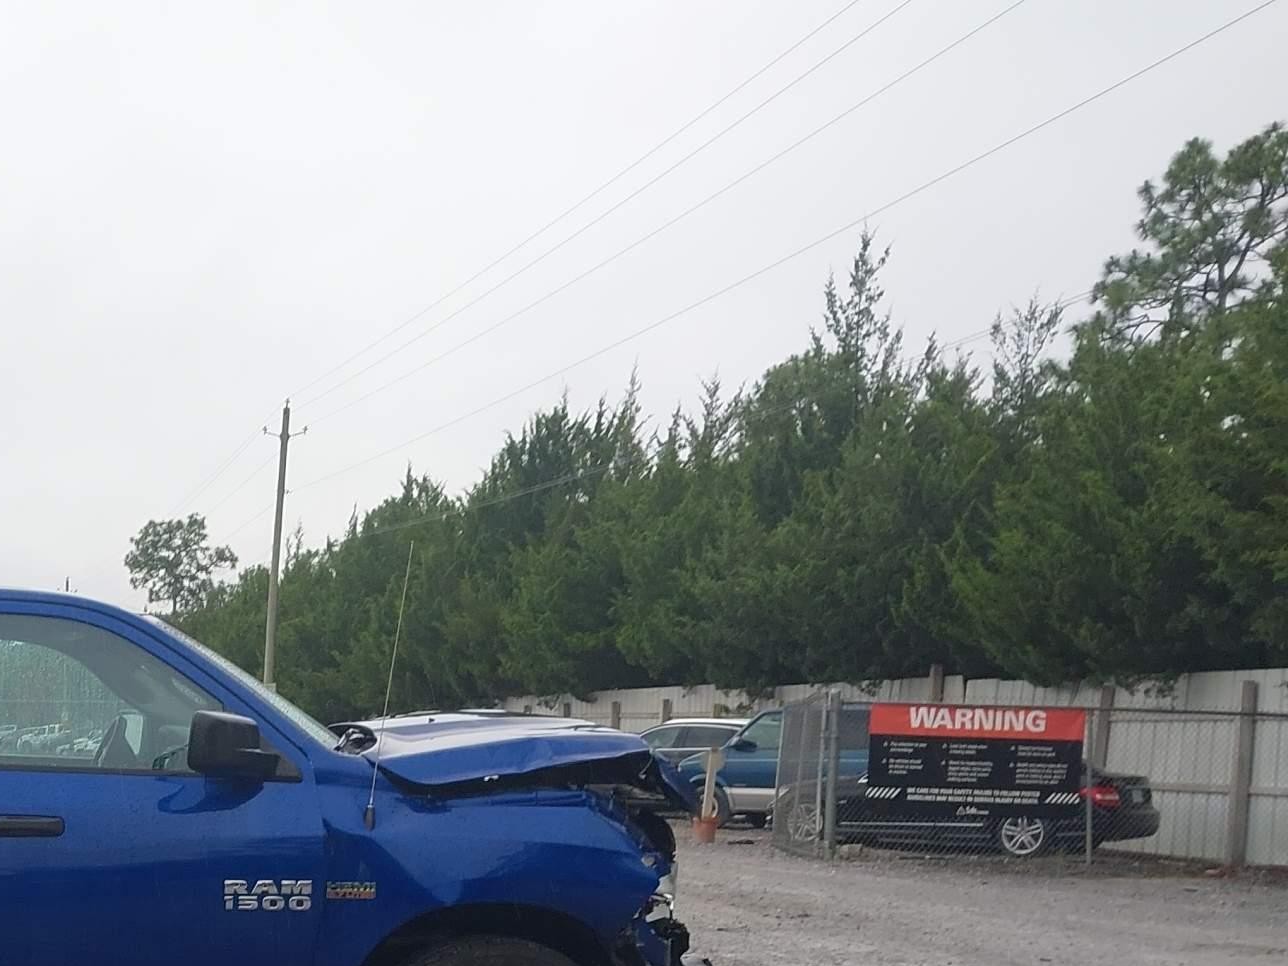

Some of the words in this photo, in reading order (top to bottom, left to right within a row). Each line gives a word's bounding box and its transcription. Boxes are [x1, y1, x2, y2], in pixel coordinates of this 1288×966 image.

[909, 706, 1047, 732] WARNING
[223, 879, 312, 895] RAM
[223, 895, 312, 911] 1500
